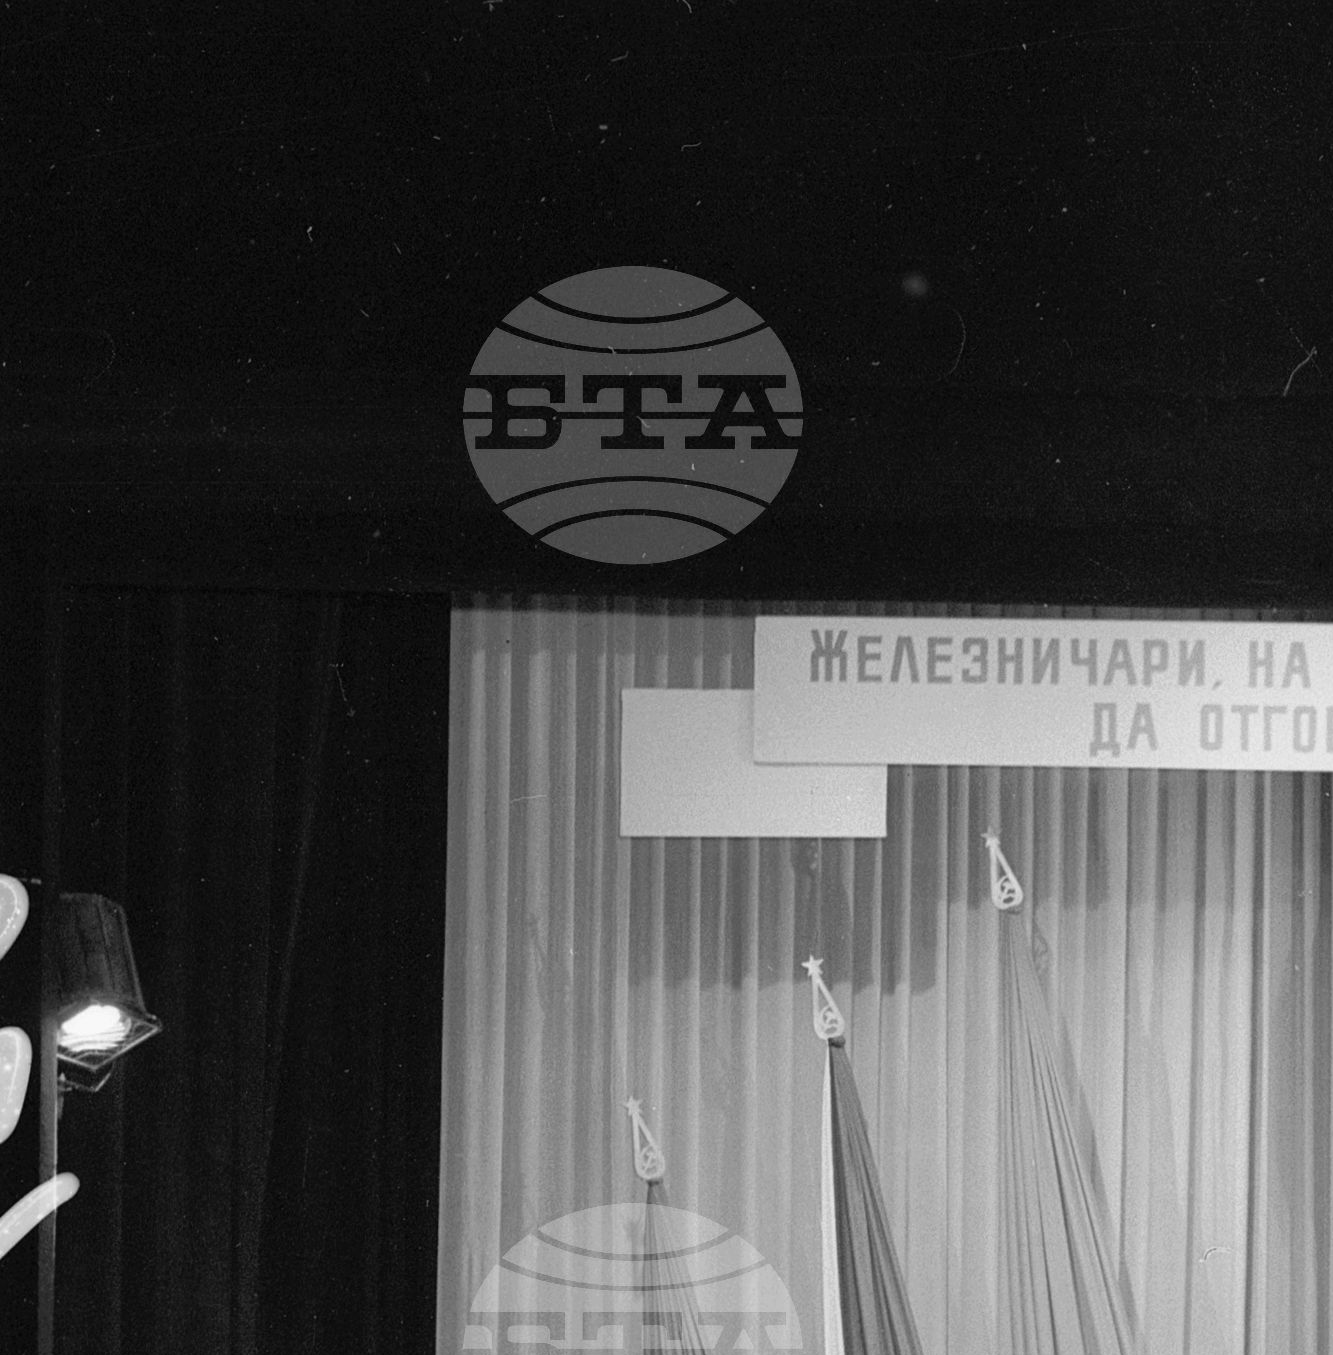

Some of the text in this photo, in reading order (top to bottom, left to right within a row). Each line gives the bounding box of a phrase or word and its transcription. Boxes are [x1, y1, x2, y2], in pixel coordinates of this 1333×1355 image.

[810, 629, 1223, 690] ЖЕЛЕЗНИЧАРИ,
[1248, 640, 1312, 689] НА
[1089, 702, 1158, 758] ДА
